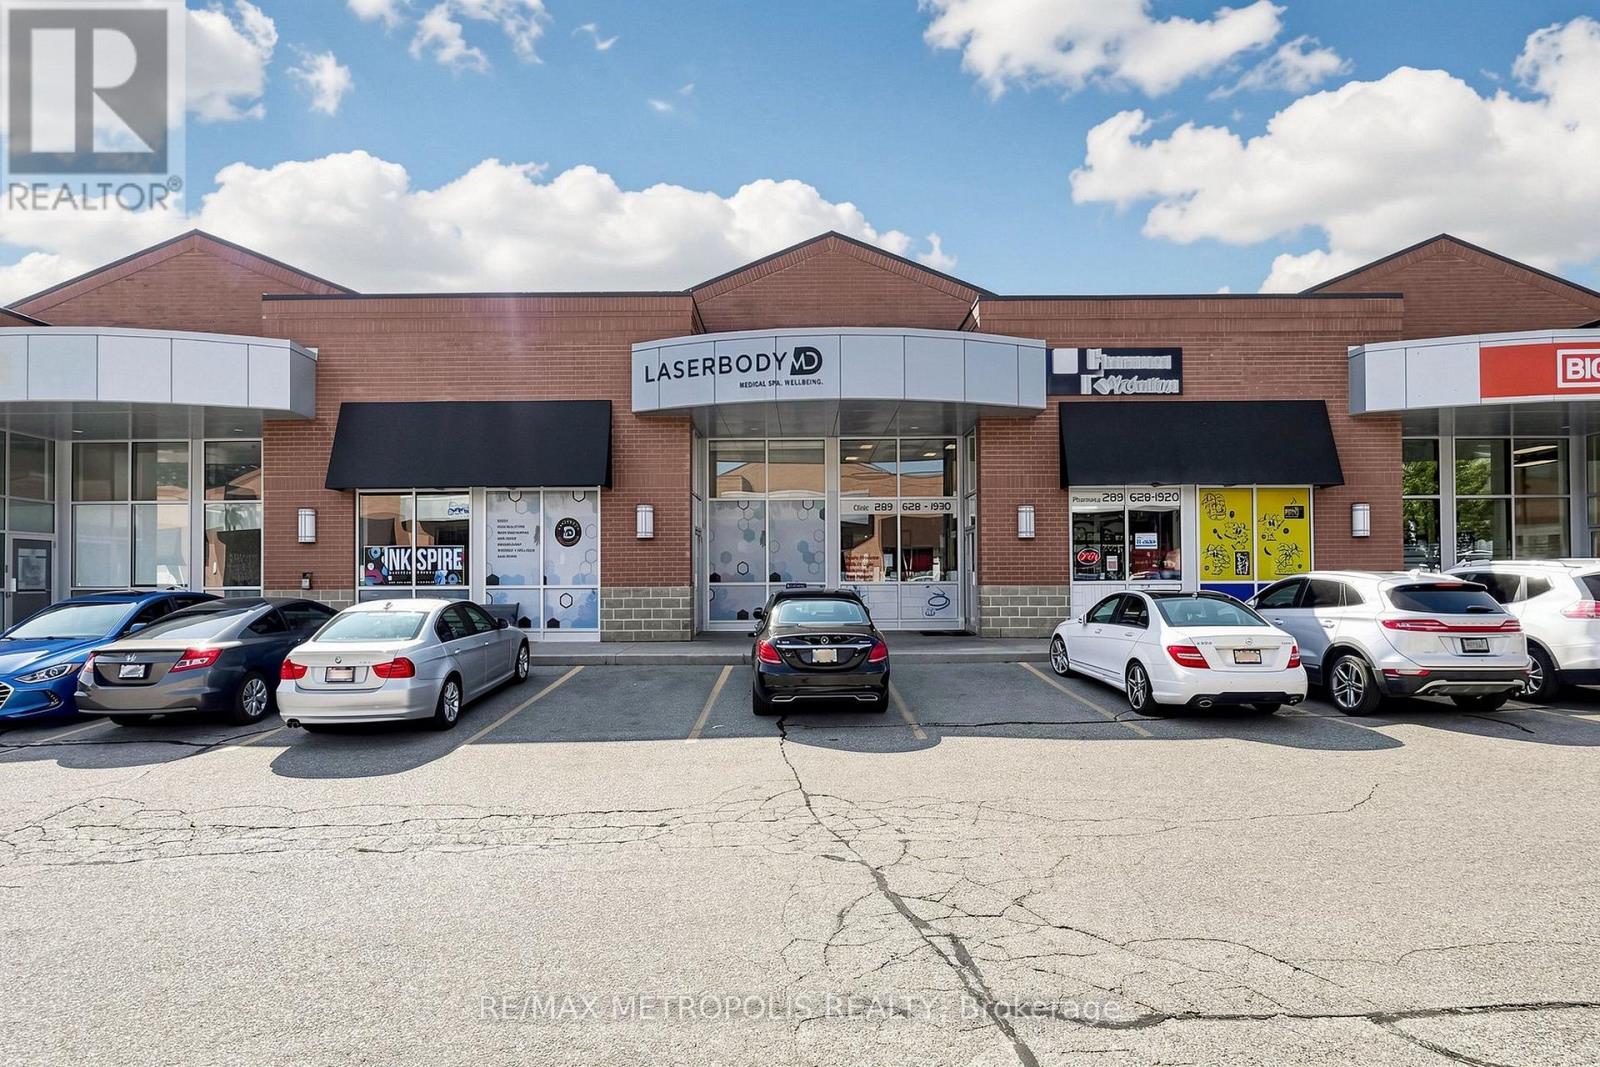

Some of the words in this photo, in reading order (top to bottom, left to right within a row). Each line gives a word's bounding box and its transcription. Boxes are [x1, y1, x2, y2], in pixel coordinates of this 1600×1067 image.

[645, 352, 787, 382] LASERBODY
[1102, 493, 1123, 502] 289
[874, 503, 893, 511] 289
[902, 503, 922, 511] 628
